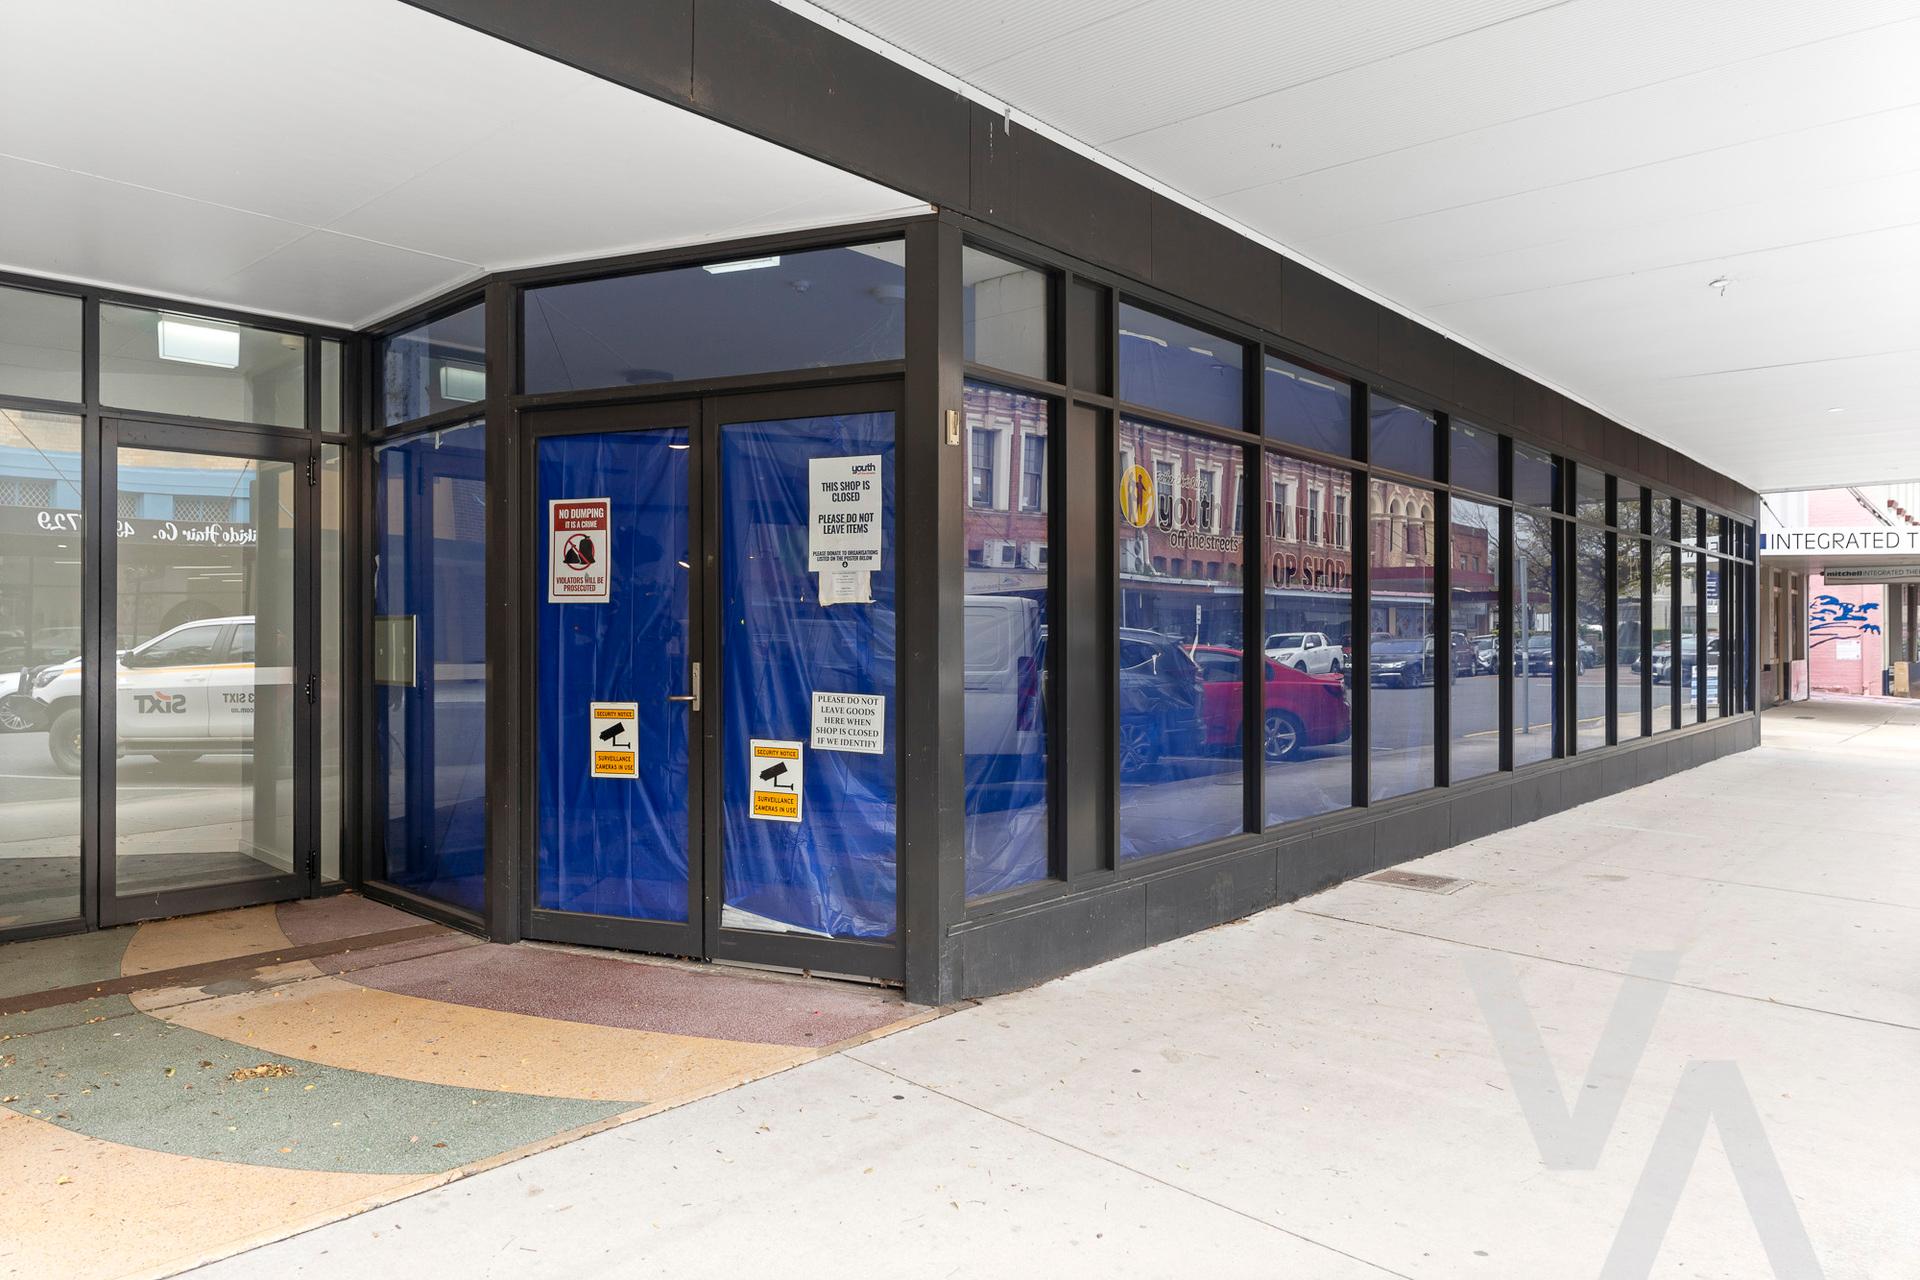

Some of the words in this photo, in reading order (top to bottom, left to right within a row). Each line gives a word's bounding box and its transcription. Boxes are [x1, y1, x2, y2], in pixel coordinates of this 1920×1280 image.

[852, 463, 875, 474] youth
[822, 482, 838, 492] THIS
[840, 481, 860, 491] SHOP
[863, 480, 870, 490] IS
[832, 492, 860, 502] CLOSED
[559, 509, 568, 519] NO
[571, 508, 604, 519] DUMPING
[1159, 493, 1222, 533] youth
[818, 514, 845, 524] PLEASE
[846, 513, 857, 522] DO
[859, 513, 874, 522] NOT
[581, 520, 597, 528] CRIME
[824, 524, 844, 534] LEAVE
[847, 524, 868, 534] ITEMS
[1170, 530, 1187, 547] off
[1188, 530, 1204, 548] the
[1206, 535, 1239, 552] streets
[1771, 532, 1900, 550] INTEGRATED
[1907, 533, 1918, 548] T
[1272, 552, 1297, 589] OP
[1302, 555, 1346, 592] SHOP
[818, 695, 845, 704] PLEASE
[821, 706, 845, 714] LEAVE
[846, 708, 875, 716] GOODS
[847, 718, 871, 726] WHEN
[848, 729, 879, 737] CLOSED
[840, 738, 877, 748] IDENTIFY
[758, 796, 794, 804] SURVEILLANCE
[756, 804, 779, 812] CAMERAS
